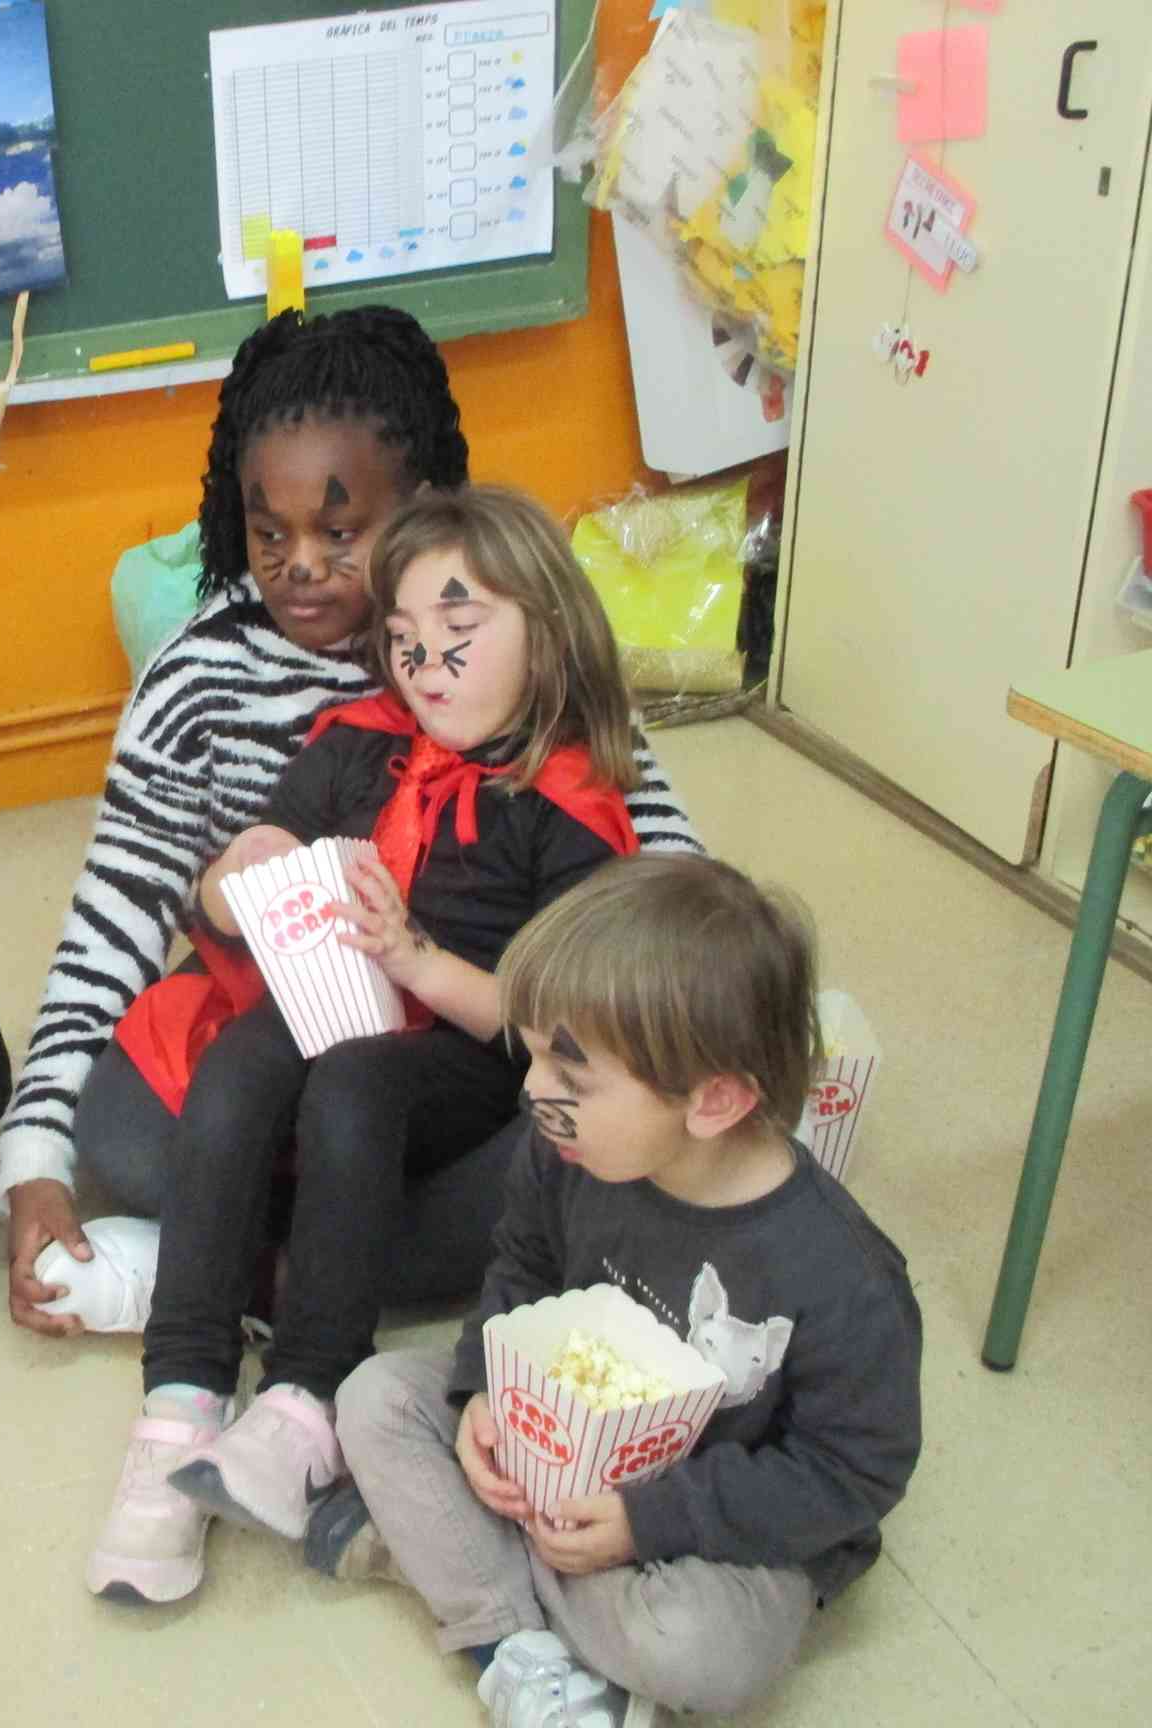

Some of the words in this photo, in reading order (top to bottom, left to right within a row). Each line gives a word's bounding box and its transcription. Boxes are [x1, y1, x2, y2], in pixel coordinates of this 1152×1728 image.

[268, 890, 313, 929] POP
[511, 1392, 556, 1433] POP
[508, 1411, 568, 1459] CORN
[617, 1427, 677, 1461] POP
[609, 1440, 684, 1479] CORN
